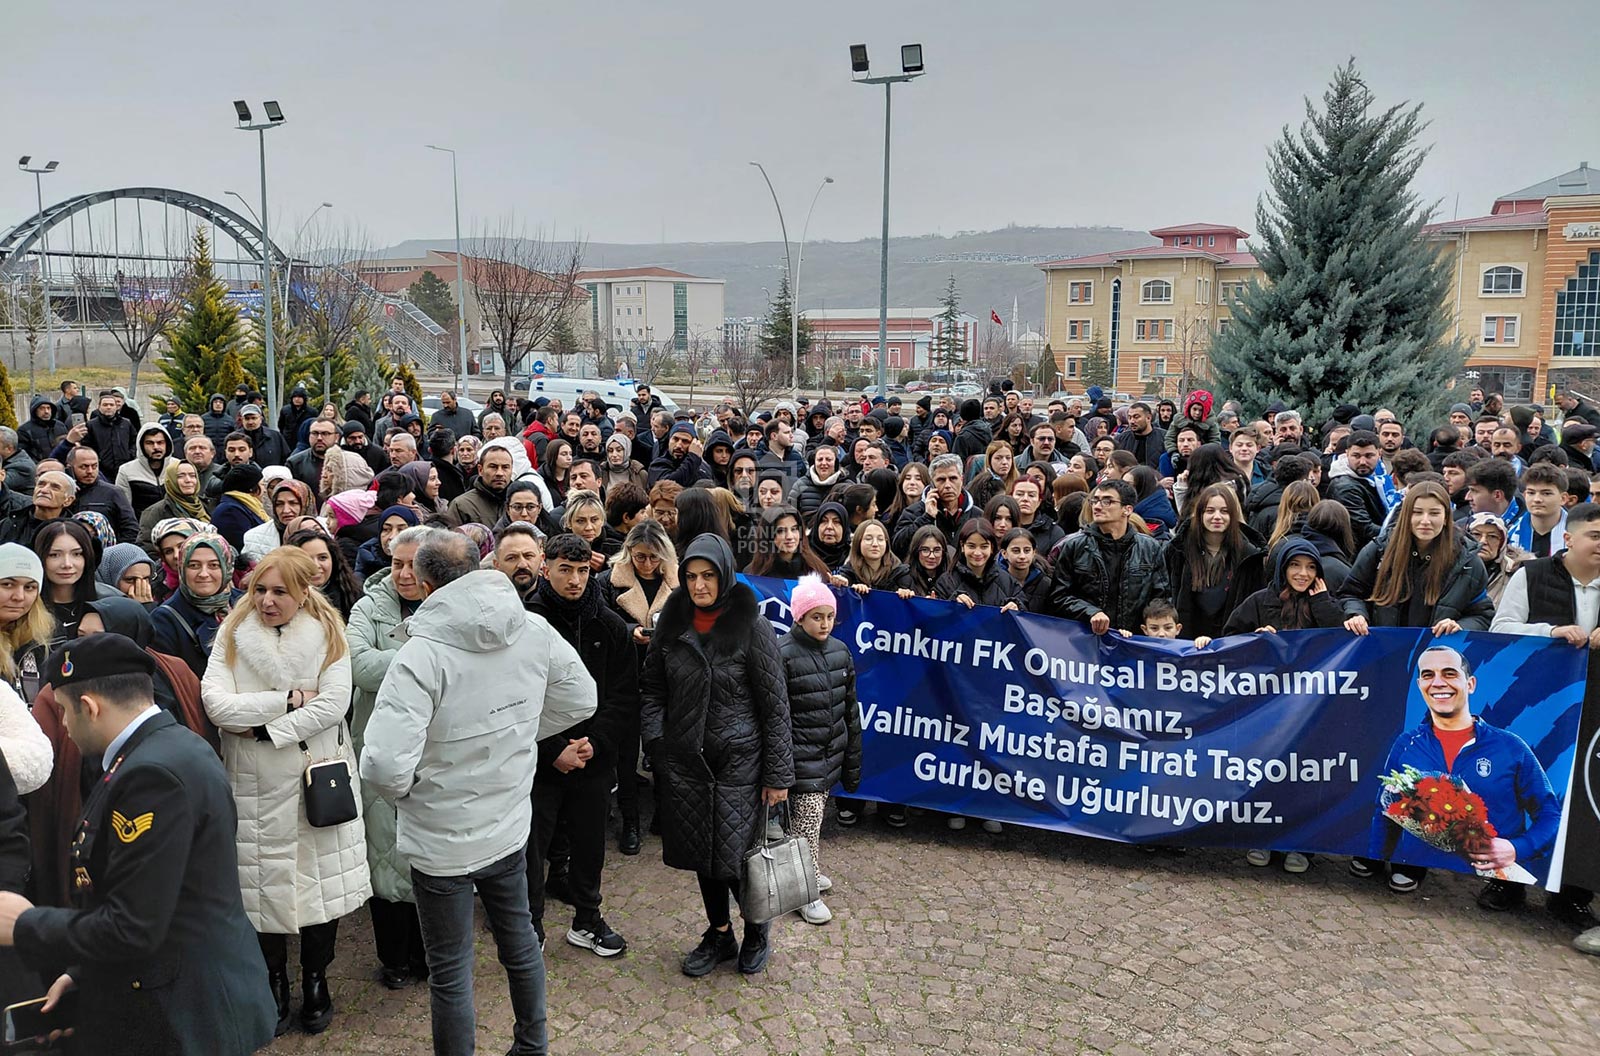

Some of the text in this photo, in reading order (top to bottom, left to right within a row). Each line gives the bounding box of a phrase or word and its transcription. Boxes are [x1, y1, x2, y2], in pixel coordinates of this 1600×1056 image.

[855, 621, 1369, 701] Çankırı FK Onursal Başkanımız,
[857, 701, 1359, 788] Valimiz Mustafa Fırat Taşolar'ı
[1003, 684, 1193, 740] Başağamız,
[913, 752, 1284, 826] Gurbete Uğurluyoruz.
